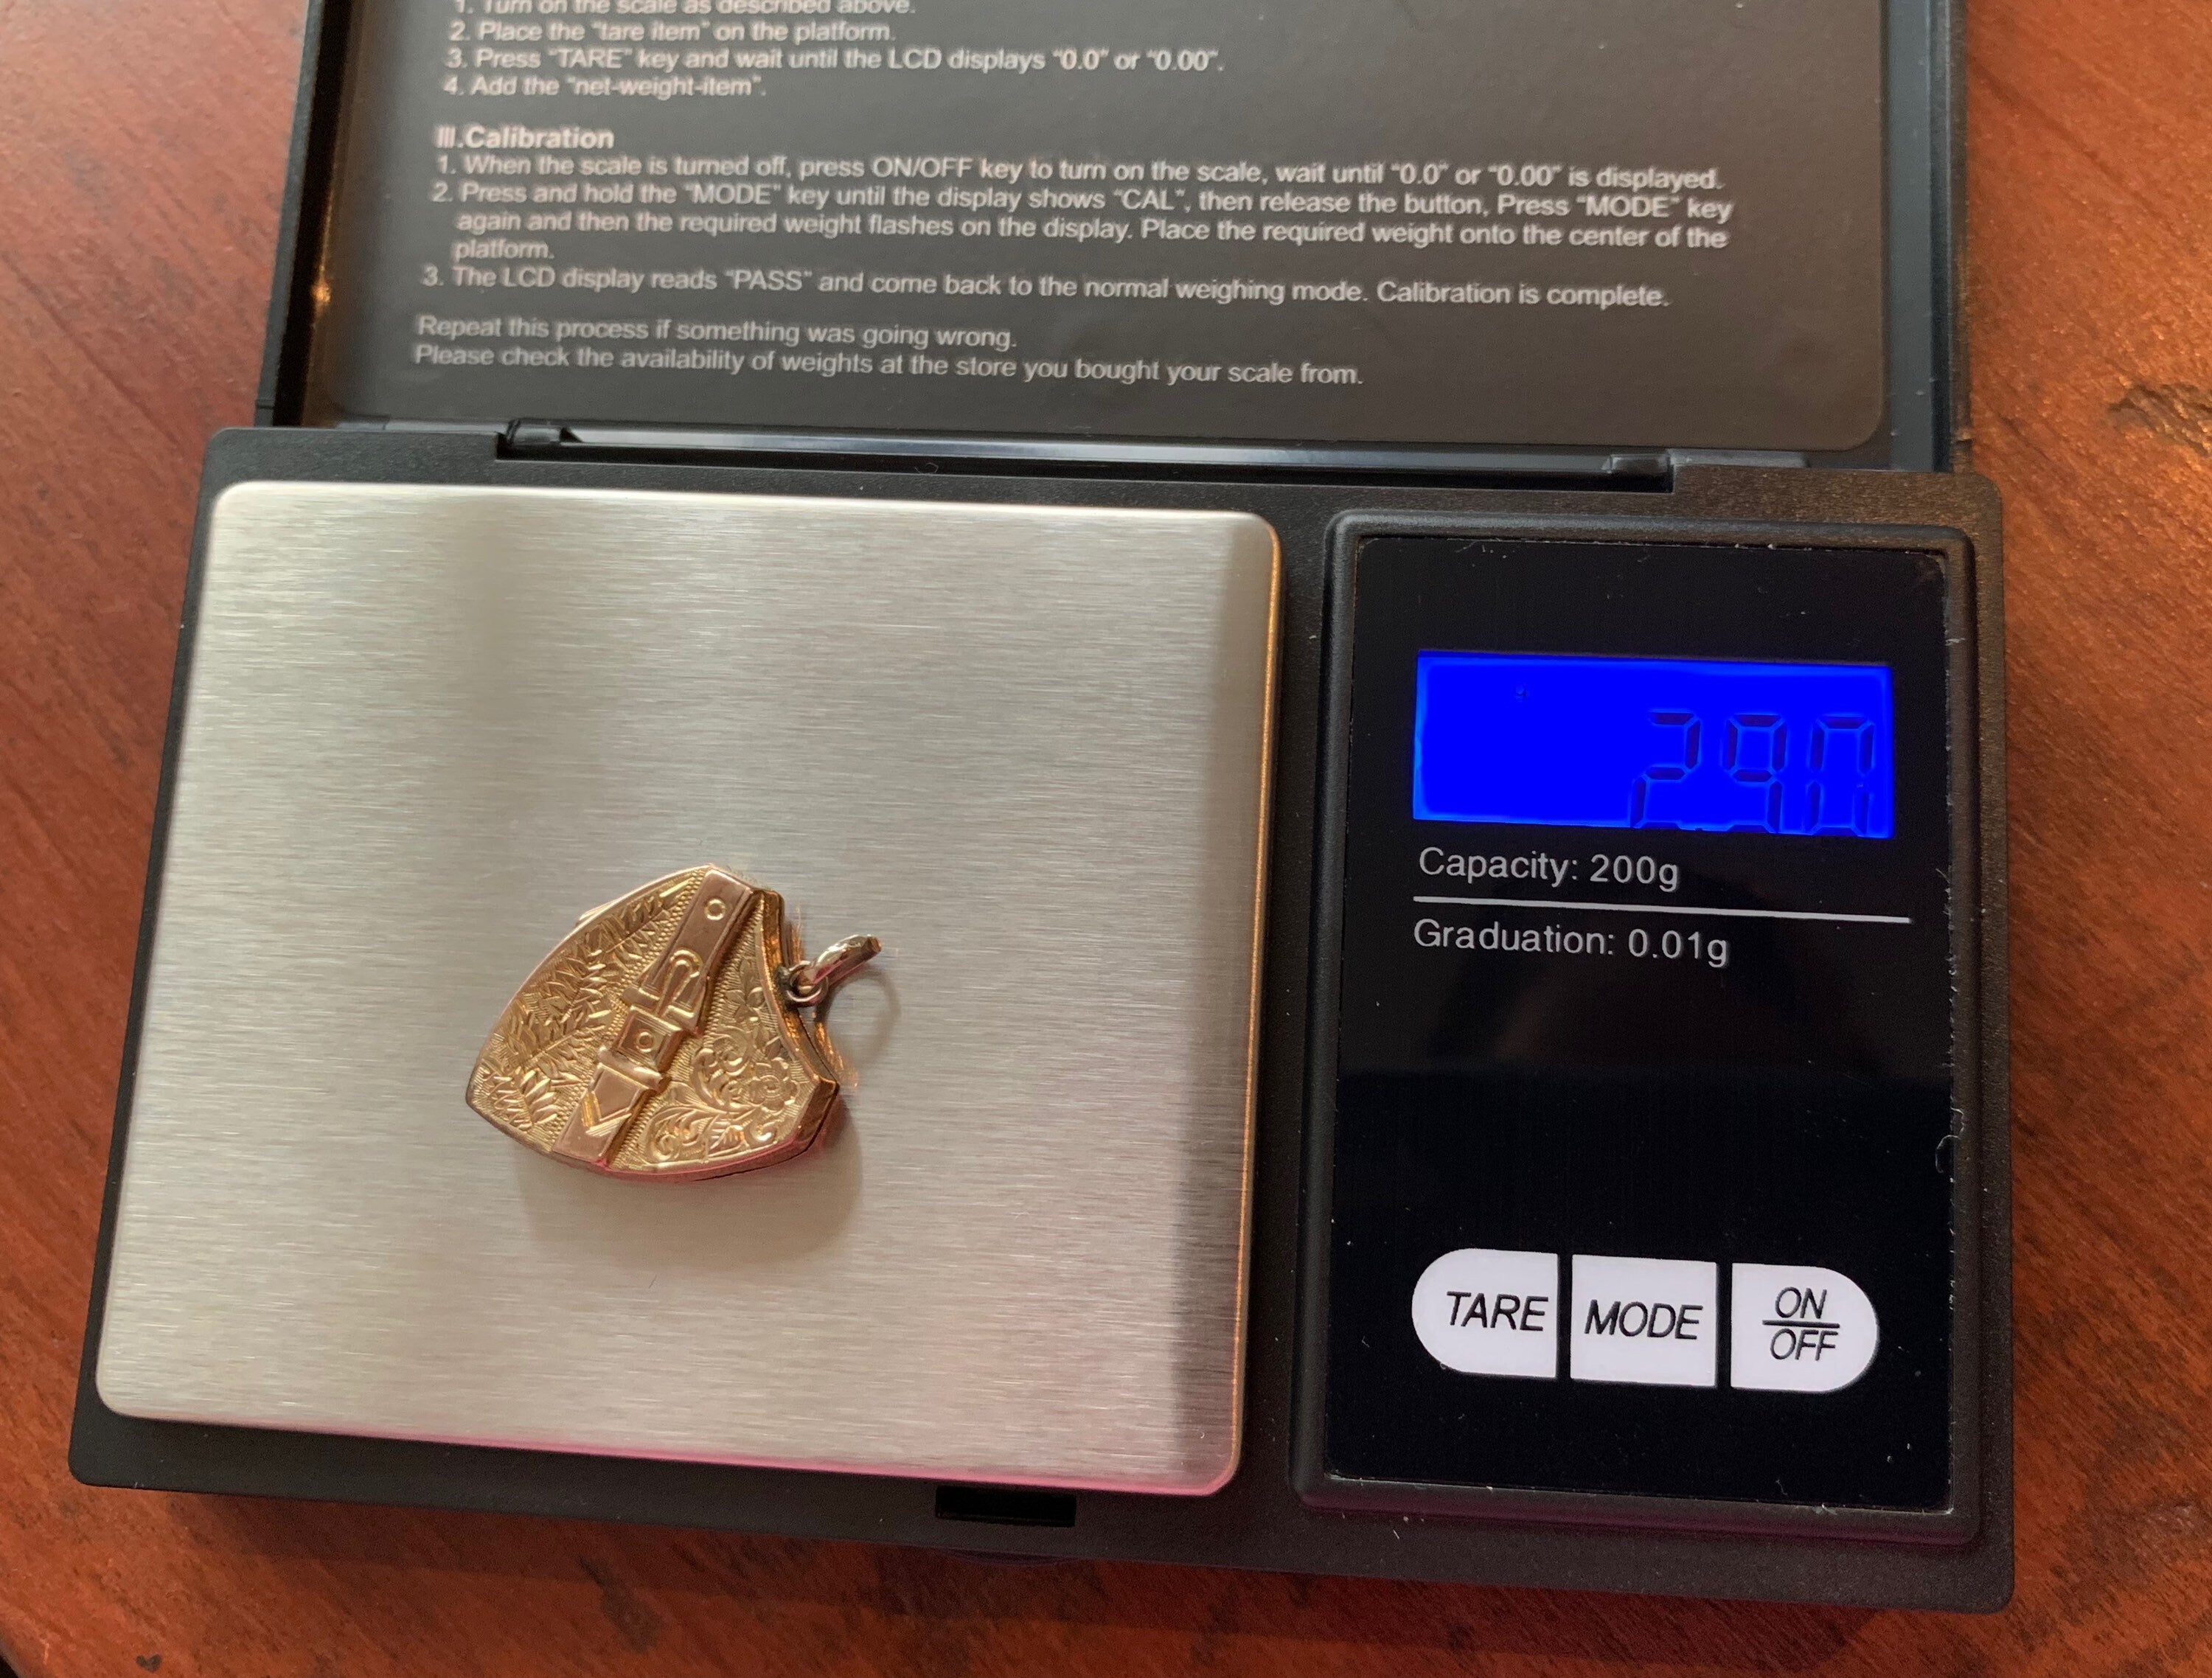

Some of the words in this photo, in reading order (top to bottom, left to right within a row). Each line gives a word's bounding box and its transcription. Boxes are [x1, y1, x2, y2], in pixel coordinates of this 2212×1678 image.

[454, 0, 473, 14] 1.
[483, 0, 532, 14] Turn
[538, 0, 568, 14] on
[573, 0, 611, 14] the
[616, 0, 677, 14] scale
[682, 0, 712, 14] as
[716, 0, 831, 14] described
[836, 0, 916, 14] above.
[449, 20, 470, 41] 2.
[477, 20, 542, 41] Place
[548, 22, 585, 41] the
[714, 24, 745, 41] on
[751, 21, 788, 41] the
[793, 21, 894, 45] platform.
[446, 47, 467, 67] 3.
[475, 47, 540, 67] Press
[637, 49, 679, 72] key
[684, 48, 729, 68] and
[734, 49, 782, 68] wait
[789, 49, 838, 68] until
[844, 48, 881, 68] the
[888, 48, 942, 69] LCD
[947, 49, 1046, 74] displays
[1114, 52, 1140, 69] or
[443, 75, 464, 94] 4.
[470, 75, 517, 95] Add
[523, 76, 560, 95] the
[439, 155, 455, 173] 1.
[464, 154, 531, 174] When
[538, 156, 574, 174] the
[580, 156, 641, 175] scale
[648, 157, 667, 174] is
[674, 156, 749, 175] turned
[756, 156, 790, 177] off,
[799, 161, 864, 181] press
[872, 158, 973, 178] ON/OFF
[980, 159, 1023, 184] key
[1029, 160, 1053, 179] to
[1060, 160, 1106, 179] turn
[1113, 164, 1144, 180] on
[1151, 161, 1189, 181] the
[1197, 162, 1267, 184] scale,
[1276, 164, 1326, 183] wait
[1332, 164, 1384, 184] until
[1455, 168, 1481, 185] or
[1568, 167, 1590, 187] is
[1596, 167, 1722, 193] displayed.
[433, 181, 451, 201] 2.
[460, 181, 526, 202] Press
[533, 184, 577, 203] and
[583, 183, 633, 203] hold
[640, 184, 676, 203] the
[787, 185, 830, 210] key
[836, 186, 885, 205] until
[893, 187, 930, 206] the
[937, 187, 1021, 212] display
[1029, 189, 1105, 209] shows
[1199, 191, 1253, 211] then
[1260, 192, 1351, 212] release
[1358, 193, 1397, 212] the
[1405, 194, 1489, 217] button,
[1498, 195, 1570, 216] Press
[1687, 198, 1733, 224] key
[457, 212, 521, 234] again
[527, 211, 571, 230] and
[577, 212, 629, 231] then
[636, 212, 672, 231] the
[680, 214, 776, 236] required
[784, 215, 860, 238] weight
[869, 215, 953, 235] flashes
[960, 220, 990, 236] on
[998, 217, 1036, 237] the
[1043, 218, 1132, 243] display.
[1141, 219, 1210, 240] Place
[1217, 220, 1256, 241] the
[1263, 222, 1366, 246] required
[1371, 223, 1453, 248] weight
[1460, 224, 1516, 245] onto
[1523, 225, 1563, 246] the
[1569, 226, 1649, 246] center
[1655, 227, 1682, 247] of
[1686, 227, 1728, 248] the
[452, 238, 554, 263] platform.
[423, 265, 442, 285] 3.
[453, 265, 496, 287] The
[502, 266, 555, 287] LCD
[562, 268, 644, 293] display
[651, 269, 717, 290] reads
[818, 272, 863, 292] and
[871, 277, 937, 293] come
[944, 274, 1001, 294] back
[1009, 276, 1032, 296] to
[1039, 276, 1077, 296] the
[1085, 279, 1169, 298] normal
[1175, 279, 1285, 304] weighing
[1292, 282, 1368, 302] mode.
[1377, 281, 1512, 303] Calibration
[1519, 284, 1540, 304] is
[1547, 285, 1669, 310] complete.
[417, 315, 501, 340] Repeat
[508, 317, 549, 337] this
[555, 321, 648, 341] process
[655, 320, 671, 338] if
[677, 322, 799, 347] something
[807, 327, 855, 343] was
[862, 325, 928, 350] going
[935, 330, 1016, 352] wrong.
[414, 344, 494, 364] Please
[501, 347, 568, 366] check
[577, 347, 613, 367] the
[621, 349, 745, 375] availability
[751, 351, 775, 370] of
[782, 352, 872, 377] weights
[880, 355, 902, 374] at
[910, 355, 948, 375] the
[956, 357, 1016, 377] store
[1023, 362, 1068, 382] you
[1075, 358, 1159, 384] bought
[1166, 365, 1222, 385] your
[1228, 362, 1293, 383] scale
[1301, 362, 1363, 384] from.
[1419, 846, 1579, 888] Capacity:
[1589, 853, 1679, 892] 200g
[1413, 918, 1615, 955] Graduation:
[1628, 928, 1729, 967] 0.01g
[1447, 1290, 1549, 1331] TARE
[1584, 1299, 1703, 1340] MODE
[1774, 1286, 1828, 1319] ON
[1769, 1327, 1839, 1361] OFF
